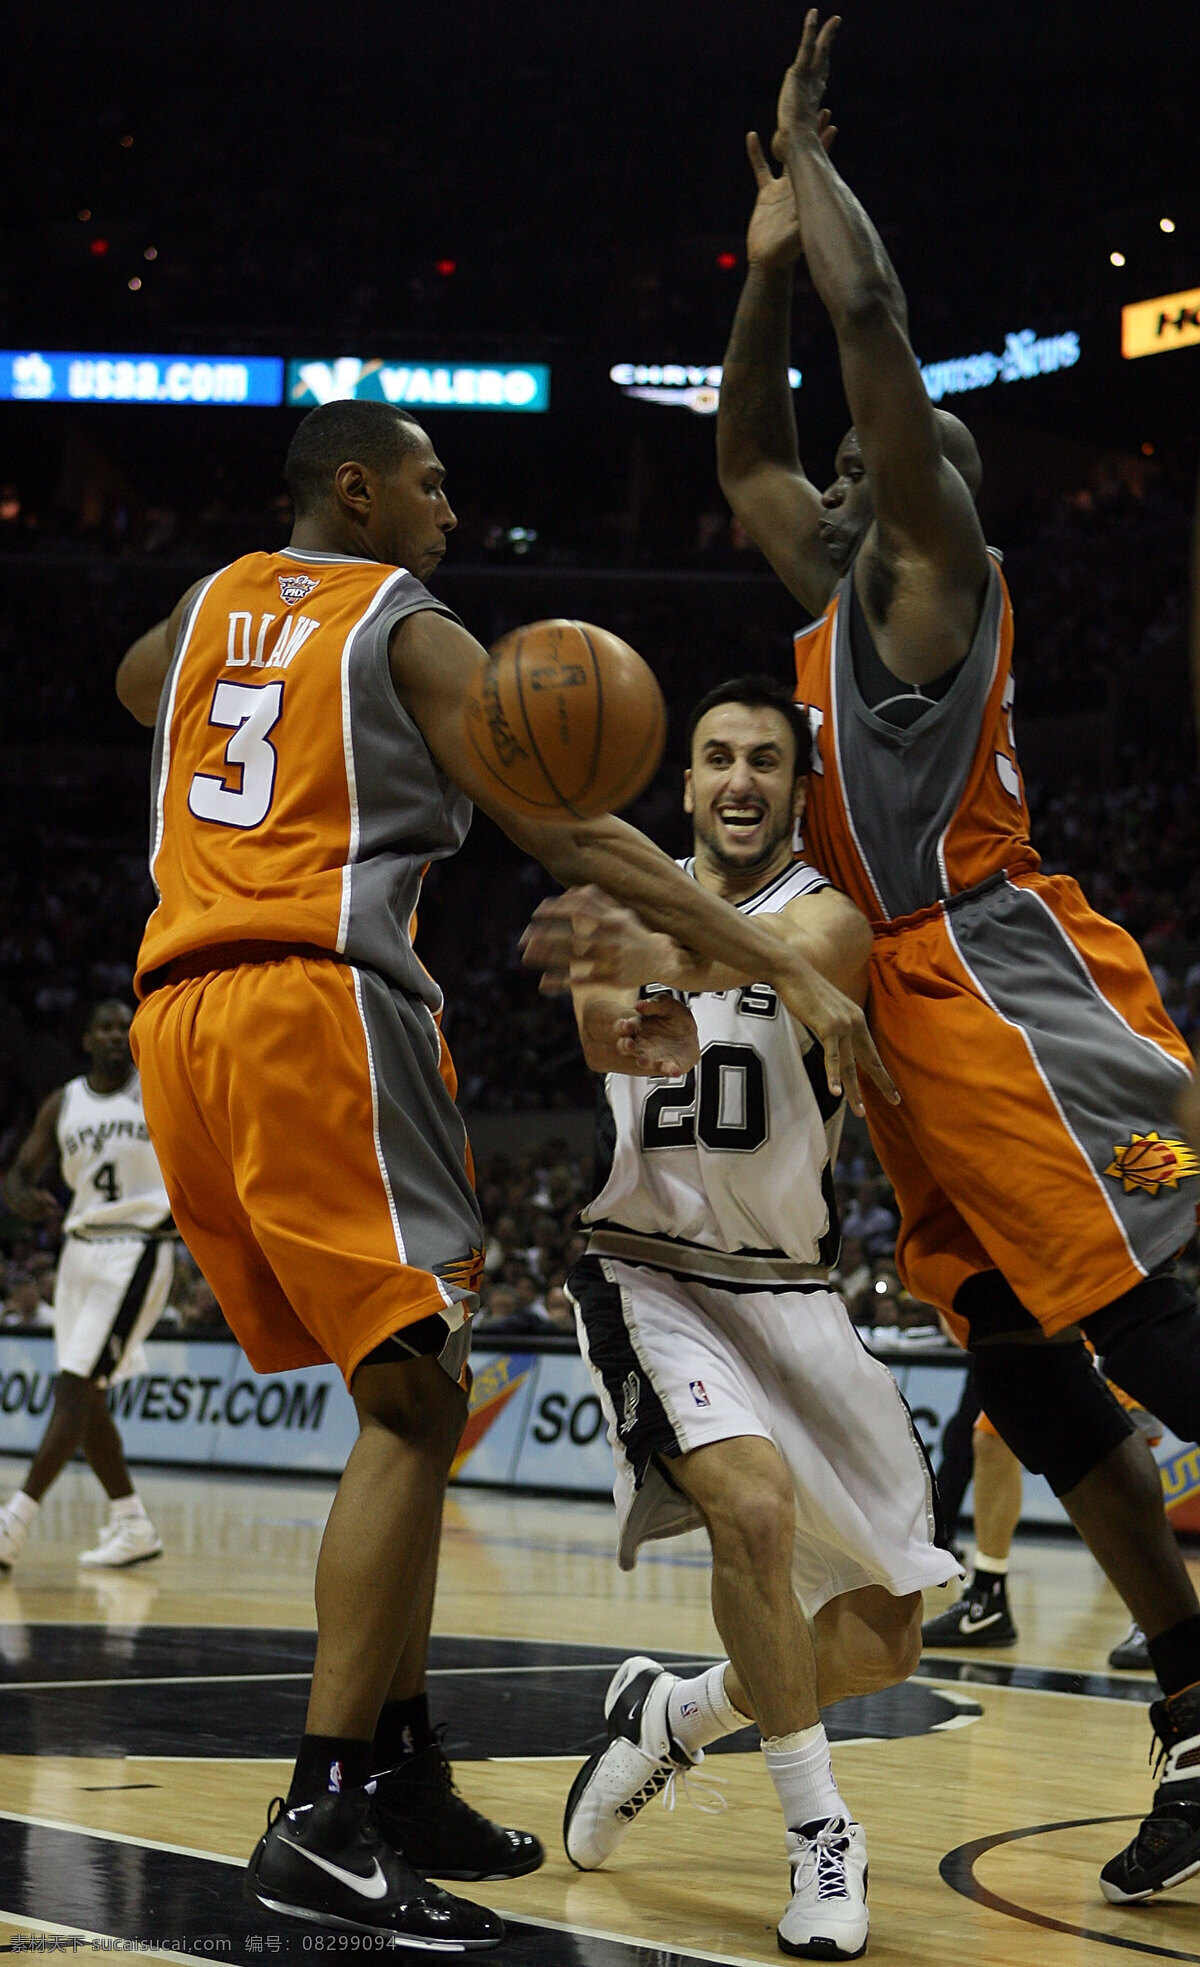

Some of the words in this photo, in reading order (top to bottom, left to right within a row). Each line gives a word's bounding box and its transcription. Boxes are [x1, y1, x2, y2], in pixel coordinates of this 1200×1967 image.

[68, 360, 249, 402] usaa.com
[379, 367, 538, 406] VALERO
[284, 587, 306, 598] PHX
[225, 611, 321, 669] DIAW
[187, 679, 286, 831] 3
[641, 1040, 770, 1154] 20
[93, 1161, 120, 1203] 4
